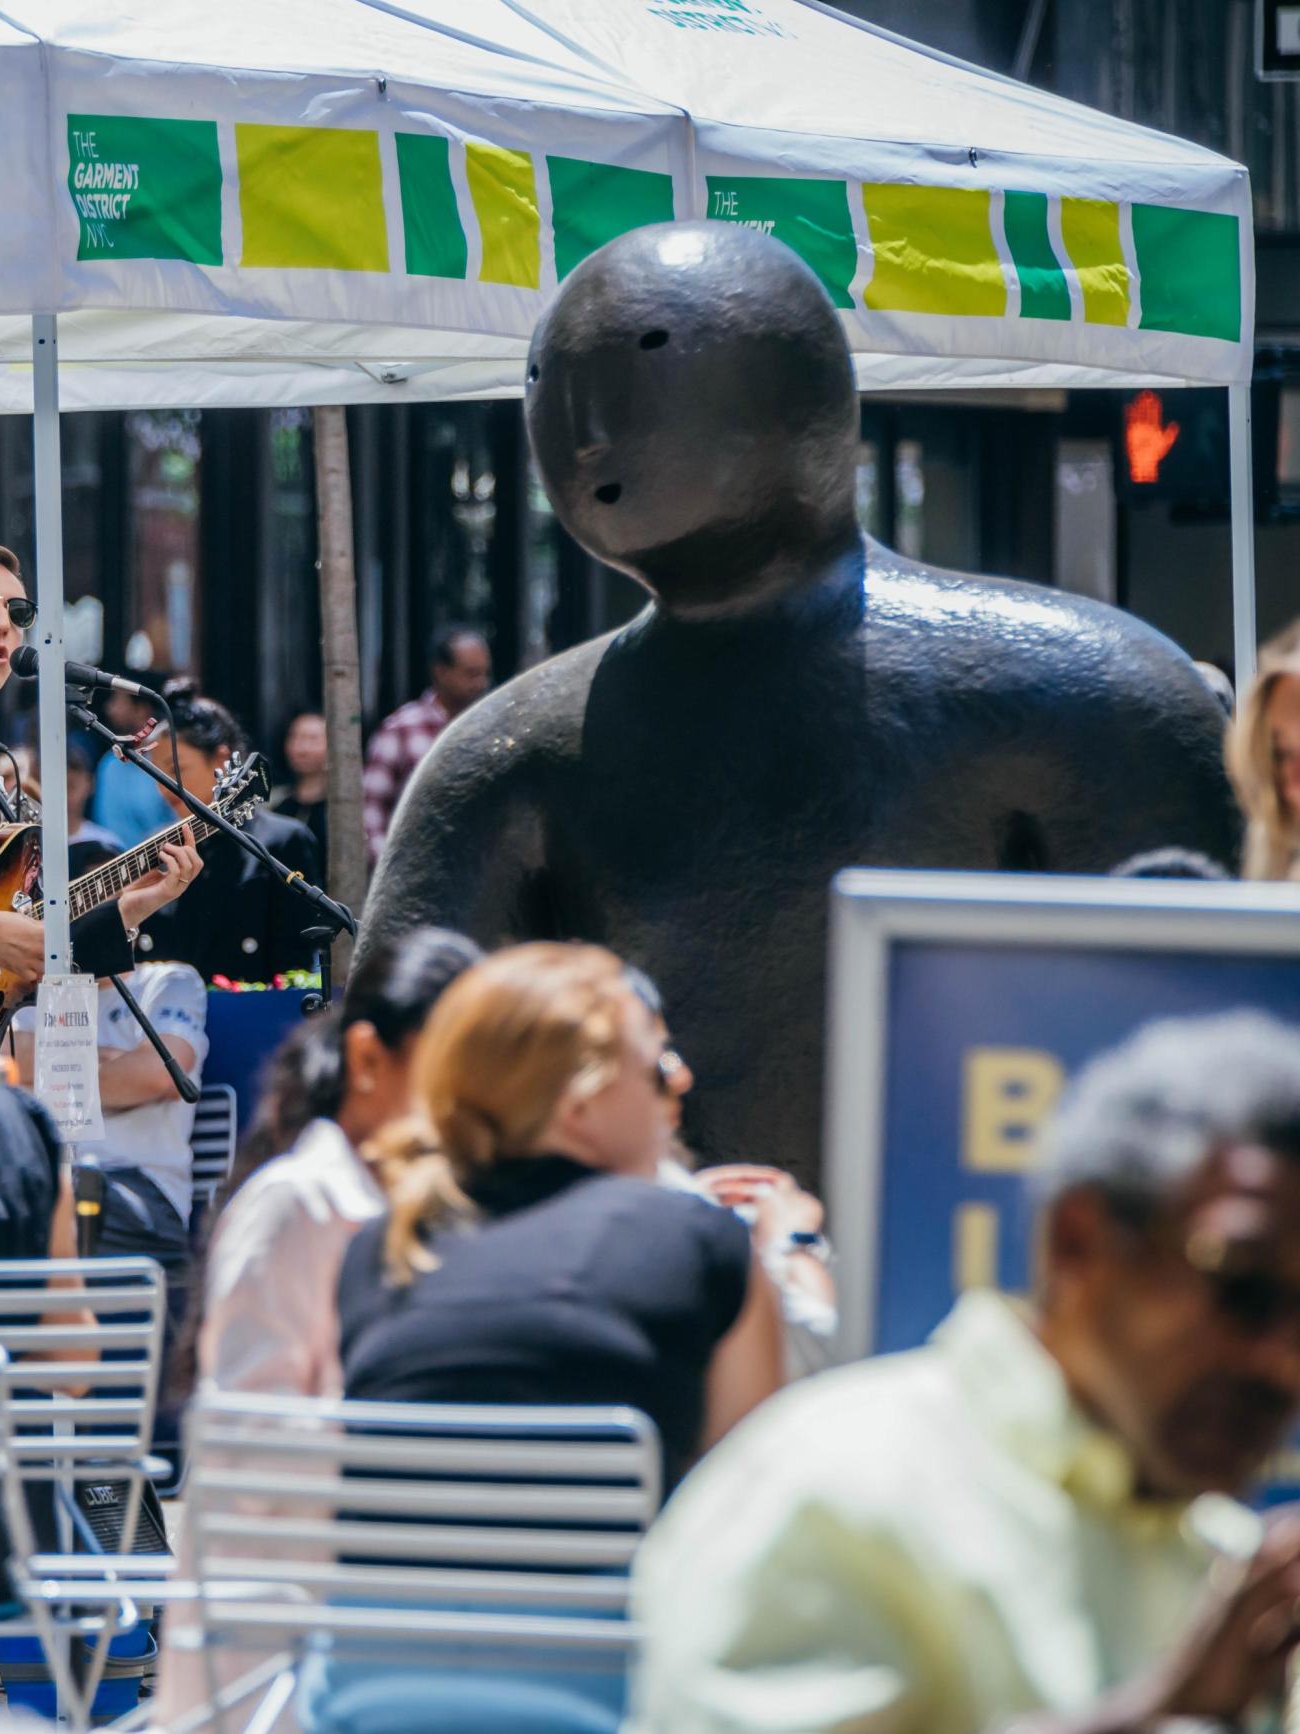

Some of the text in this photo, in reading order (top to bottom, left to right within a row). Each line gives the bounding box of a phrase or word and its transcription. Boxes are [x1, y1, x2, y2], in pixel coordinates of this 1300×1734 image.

[73, 131, 99, 157] THE
[75, 163, 139, 190] GARMENT
[75, 194, 131, 219] DISTRICT
[714, 191, 739, 216] THE
[86, 223, 115, 248] NYC
